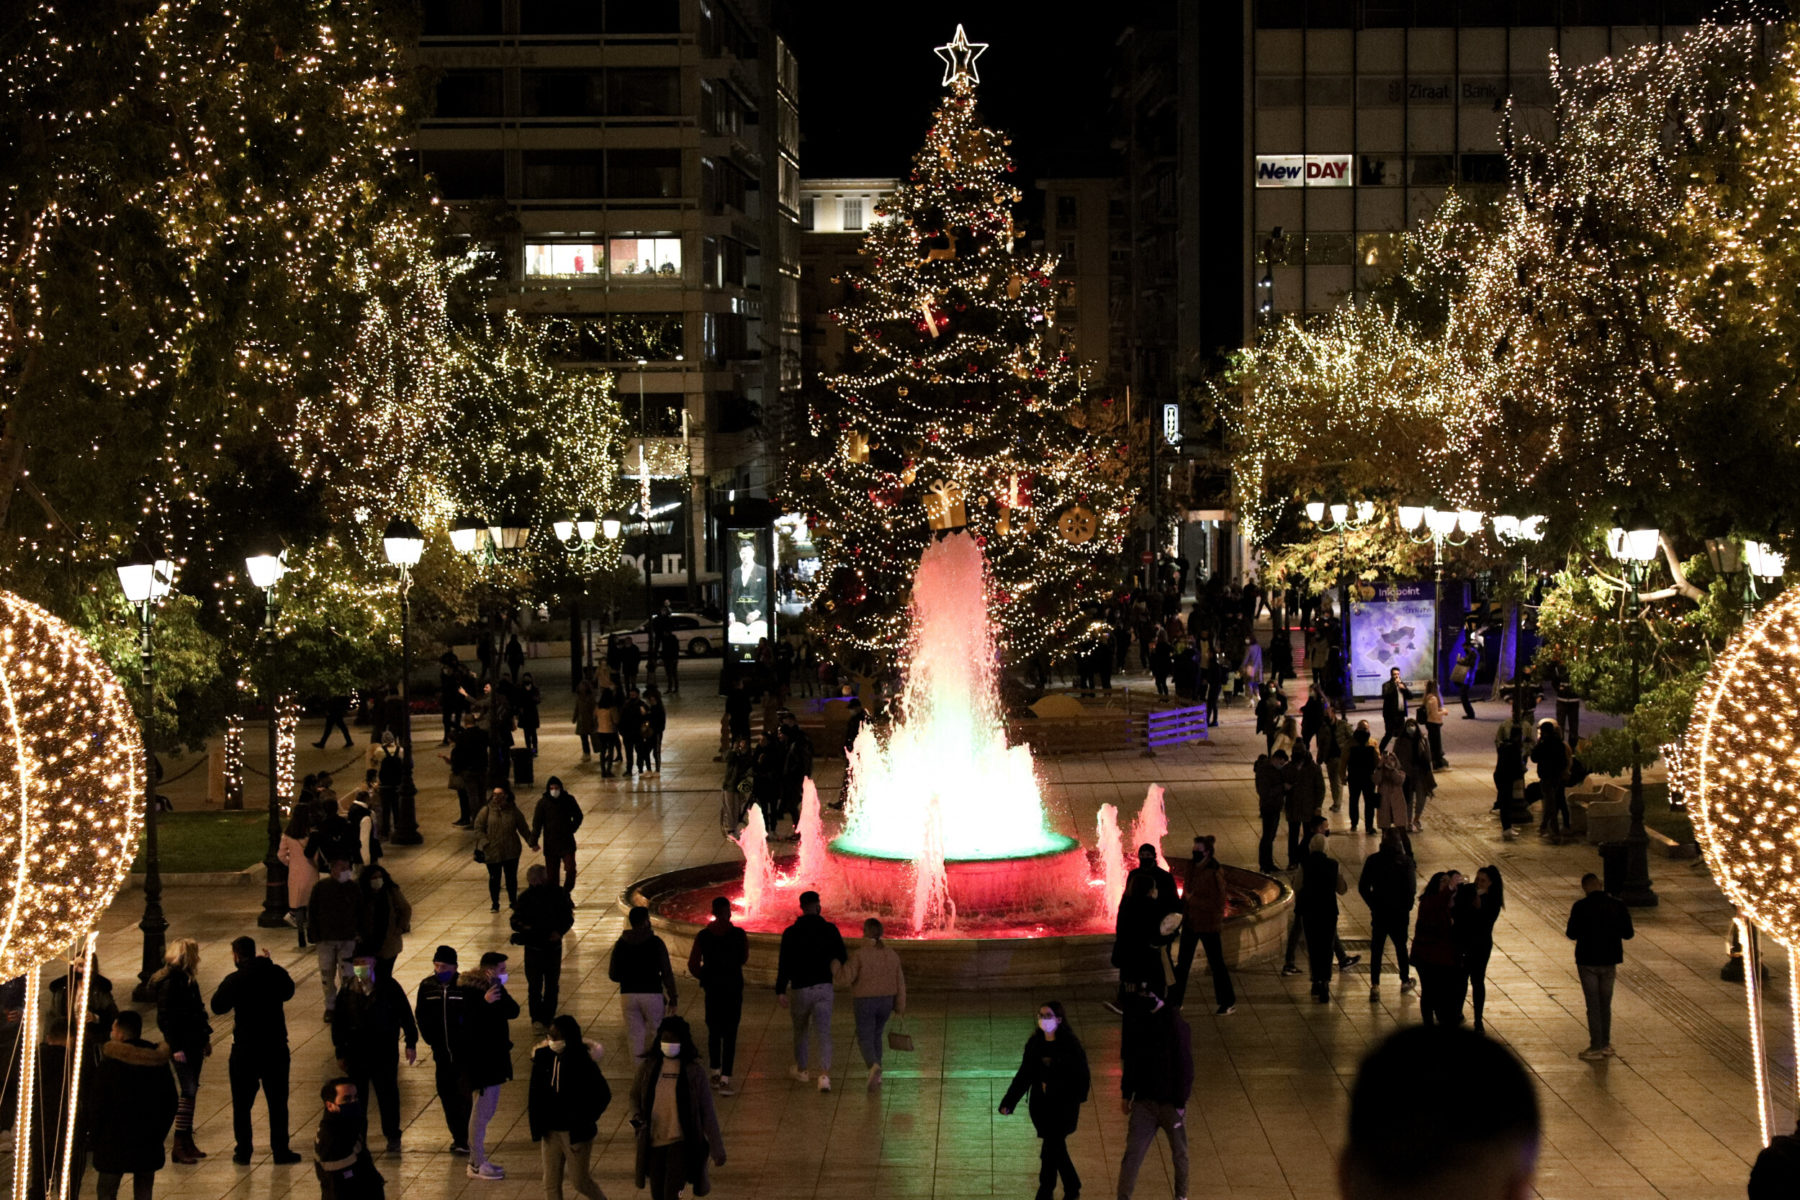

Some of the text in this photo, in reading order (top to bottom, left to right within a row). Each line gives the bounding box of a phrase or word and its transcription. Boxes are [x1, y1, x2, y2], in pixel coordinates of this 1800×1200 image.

[1409, 83, 1496, 99] Ziraat Bank
[1259, 162, 1349, 179] New DAY
